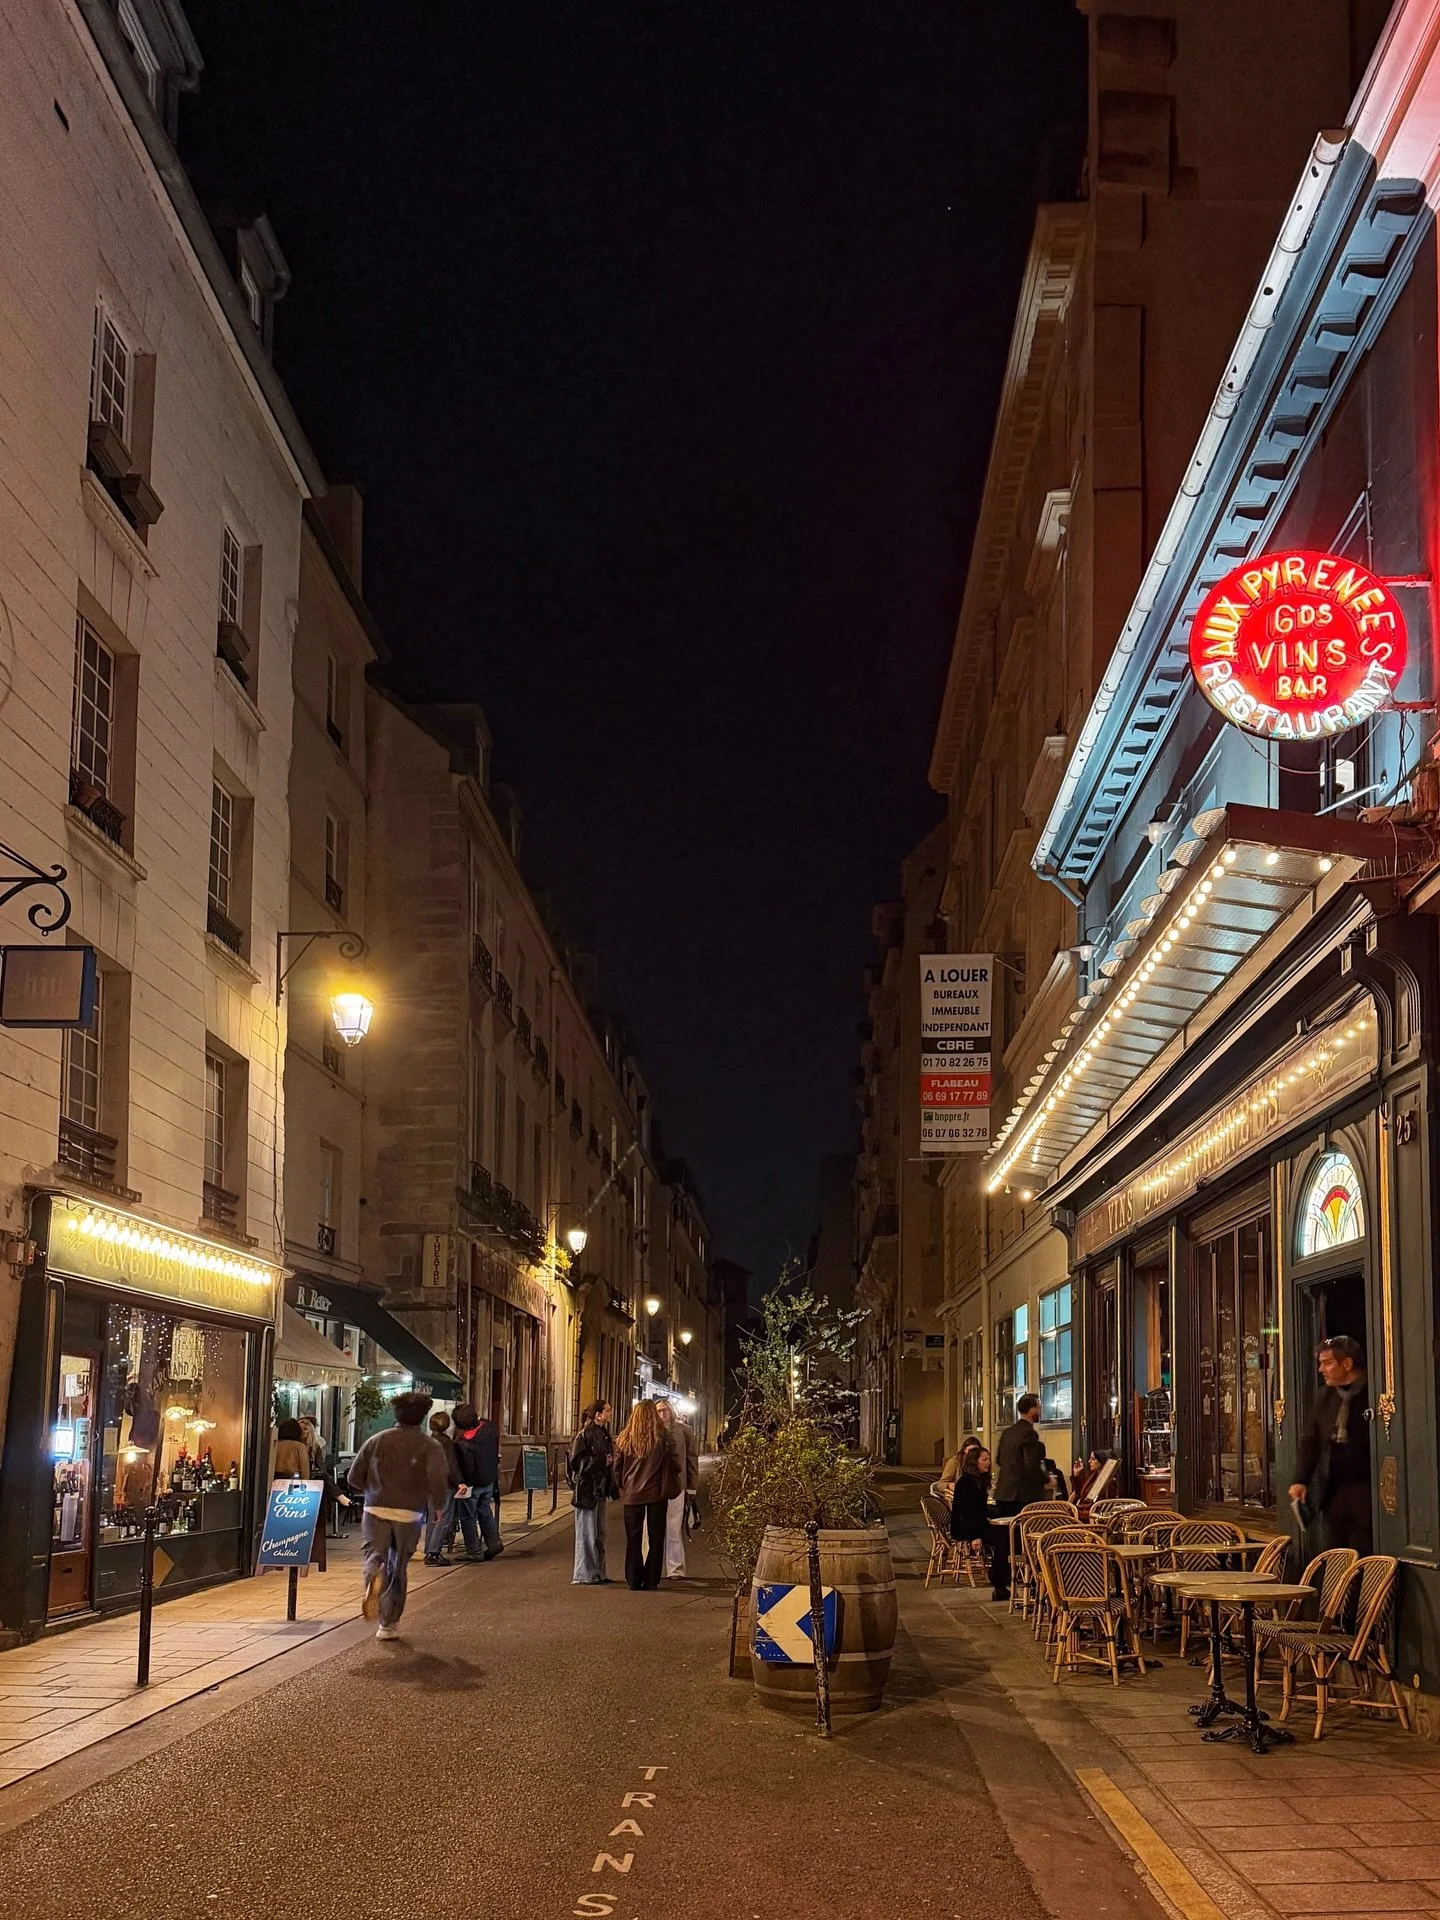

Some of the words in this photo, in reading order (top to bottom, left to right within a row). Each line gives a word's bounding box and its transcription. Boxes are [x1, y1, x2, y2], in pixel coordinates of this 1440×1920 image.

[1203, 596, 1249, 658] AUX
[1242, 557, 1396, 662] PYRENEES
[1275, 604, 1333, 633] GDS
[1252, 639, 1346, 669] VINS
[1278, 675, 1327, 696] BAR
[1201, 660, 1397, 739] RESTAURANT
[924, 969, 935, 983] A
[940, 968, 988, 983] LOUER
[933, 989, 979, 999] BUREAUX
[931, 1006, 980, 1016] IMMEUBLE
[922, 1022, 989, 1032] INDEPENDANT
[936, 1040, 974, 1051] CBRE
[923, 1057, 933, 1067] 01
[935, 1057, 946, 1067] 70
[949, 1057, 960, 1067] 82
[963, 1057, 974, 1067] 26
[977, 1057, 988, 1067] 75
[931, 1079, 979, 1088] FLABEAU
[923, 1091, 933, 1101] 06
[936, 1091, 946, 1101] 69
[950, 1091, 960, 1101] 17
[963, 1091, 973, 1101] 77
[977, 1091, 987, 1101] 89
[934, 1111, 970, 1122] bnppre.fr
[923, 1128, 932, 1138] 06
[936, 1128, 946, 1138] 07
[949, 1128, 960, 1138] 06
[963, 1128, 973, 1138] 32
[977, 1128, 987, 1138] 78
[1396, 1111, 1411, 1146] 25
[1108, 1189, 1133, 1234] VINS
[275, 1491, 310, 1504] Cave
[273, 1504, 309, 1518] Vins
[262, 1530, 309, 1553] Champagne
